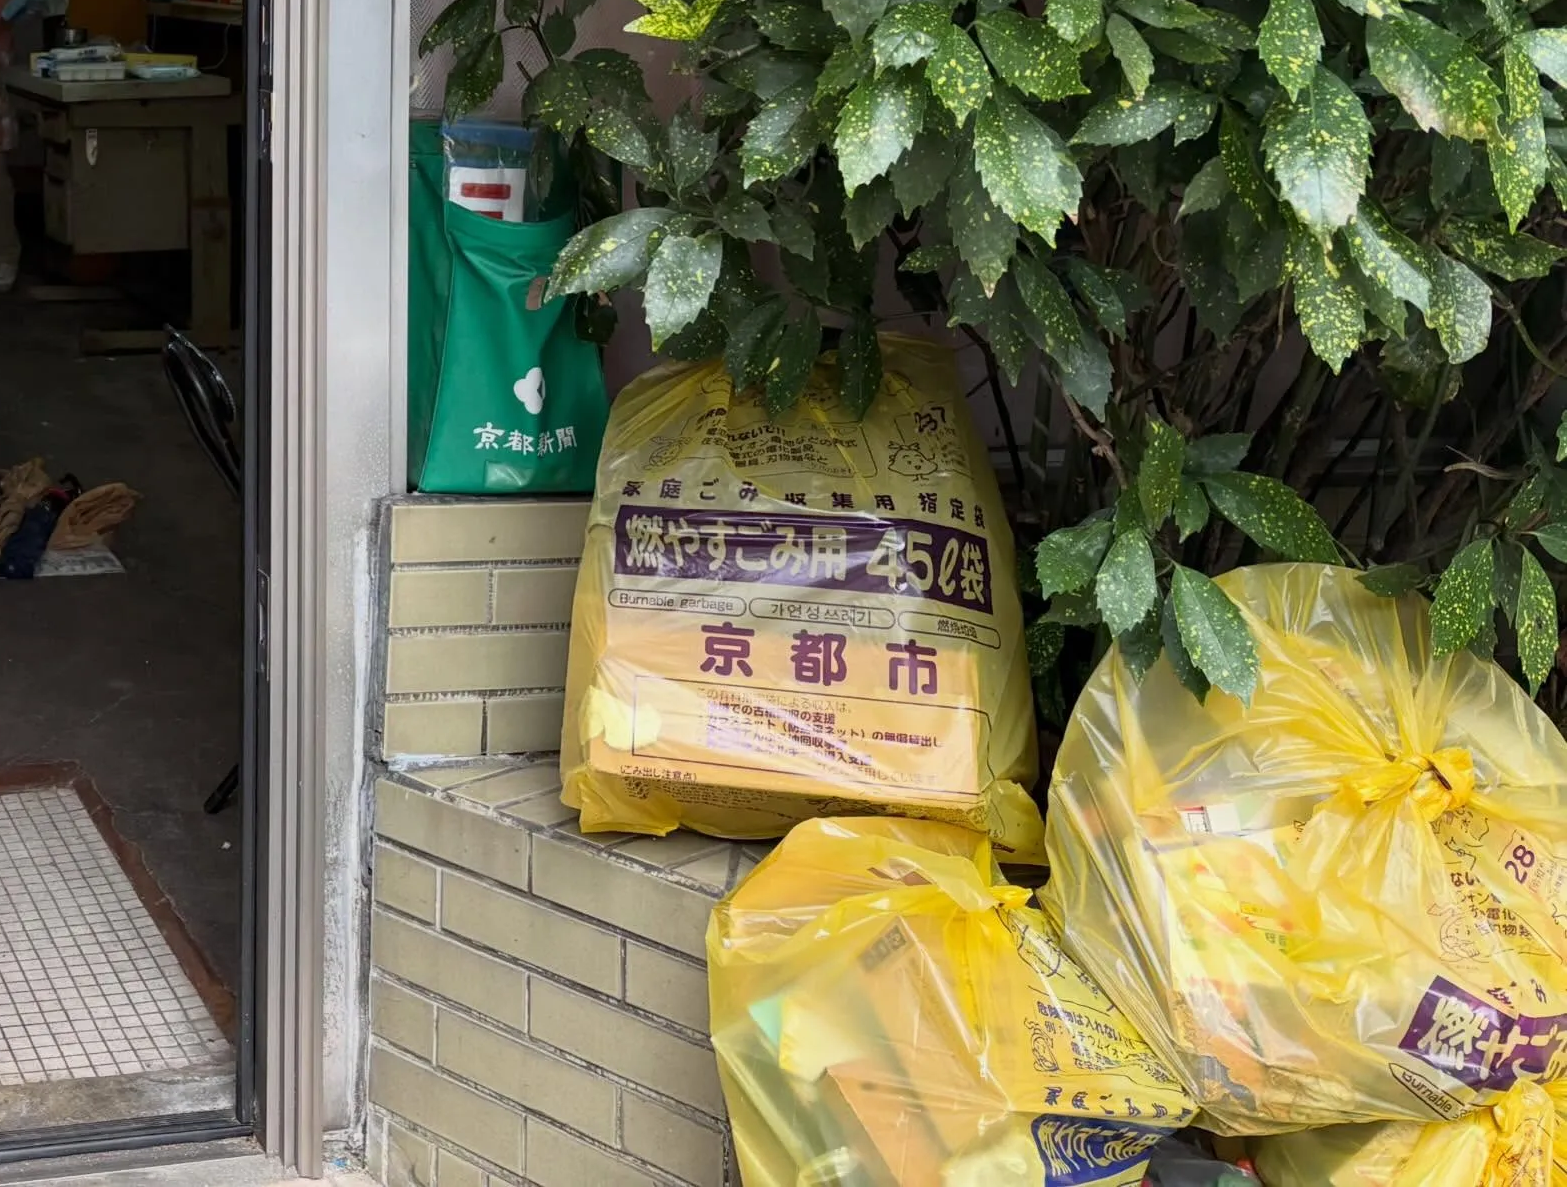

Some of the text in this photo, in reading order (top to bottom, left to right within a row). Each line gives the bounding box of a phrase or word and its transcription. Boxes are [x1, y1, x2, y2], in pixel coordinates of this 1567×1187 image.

[473, 421, 578, 457] 京都新聞
[625, 513, 849, 582] 燃やすごみ用
[619, 593, 733, 612] Burnable garbage
[699, 621, 938, 695] 京都市
[1504, 844, 1535, 884] 28
